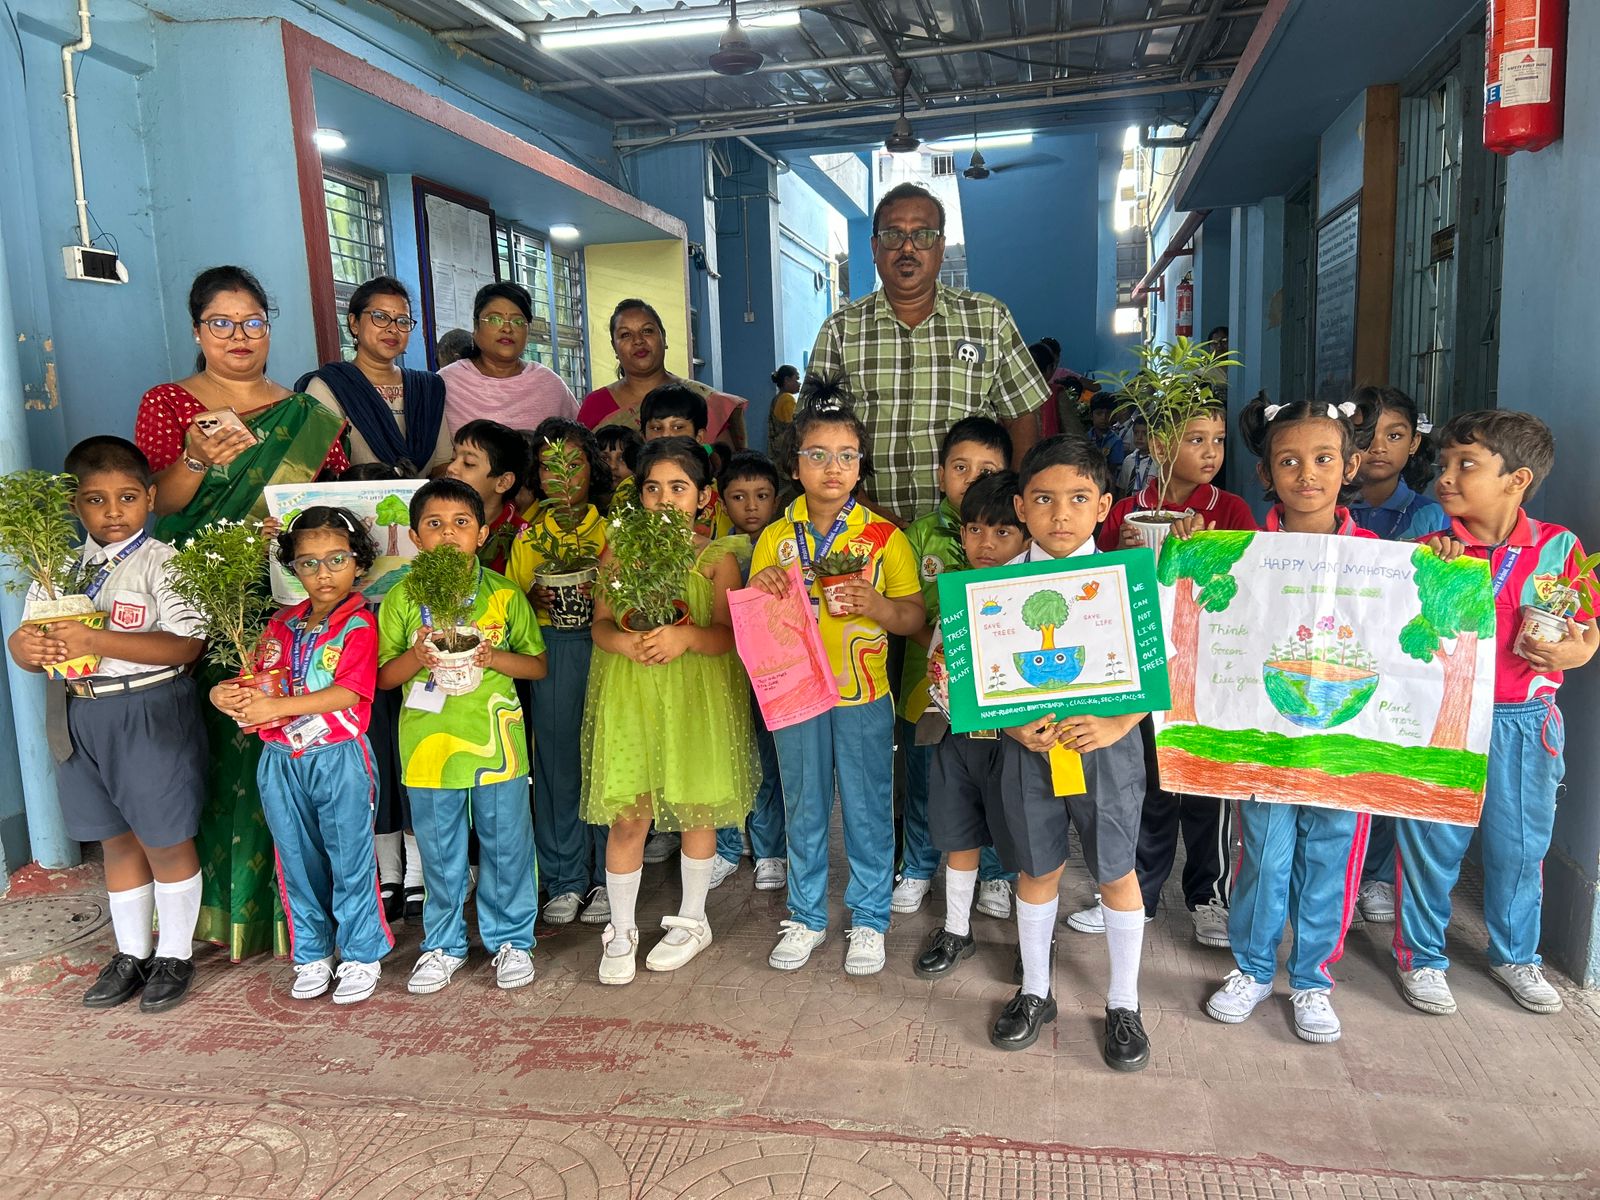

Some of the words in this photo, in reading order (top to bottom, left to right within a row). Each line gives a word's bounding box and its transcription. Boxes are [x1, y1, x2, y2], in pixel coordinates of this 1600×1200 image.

[1260, 558, 1304, 572] HAPPY
[1308, 561, 1338, 572] VAN
[1343, 564, 1411, 580] MAHOTSAV
[1132, 582, 1144, 592] WE
[1133, 598, 1148, 609] CAN
[943, 609, 964, 624] PLANT
[1138, 610, 1151, 622] NOT
[984, 622, 1000, 630] SAVE
[992, 628, 1015, 636] TREES
[1137, 622, 1157, 636] LIVE
[1208, 624, 1248, 635] Think
[946, 626, 968, 643] TREES
[1139, 636, 1158, 648] WITH
[948, 644, 966, 656] SAVE
[1142, 648, 1157, 660] OUT
[950, 657, 966, 669] THE
[1141, 657, 1164, 672] TREES
[950, 666, 970, 683] PLANT
